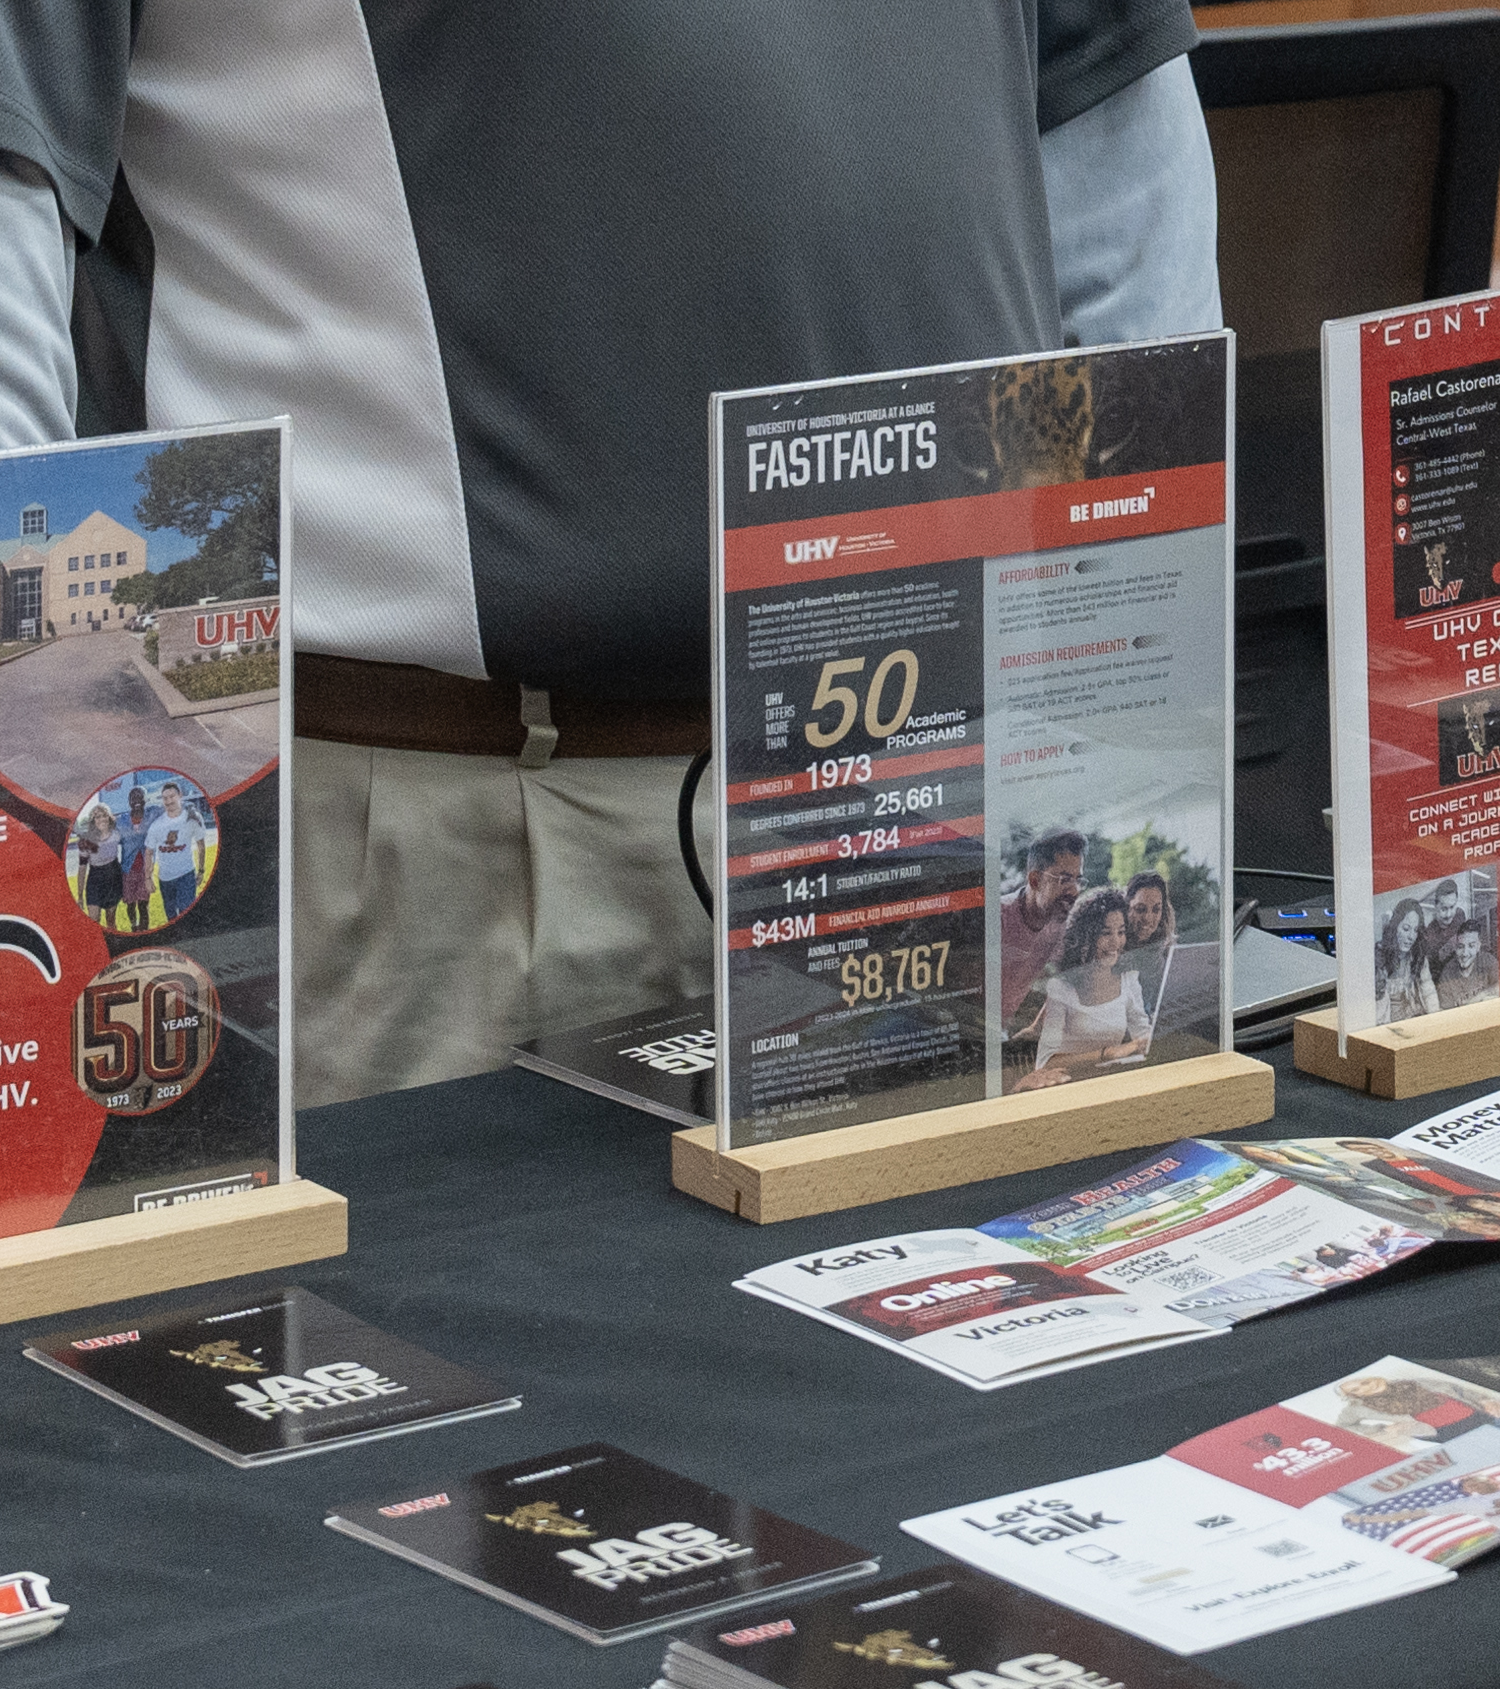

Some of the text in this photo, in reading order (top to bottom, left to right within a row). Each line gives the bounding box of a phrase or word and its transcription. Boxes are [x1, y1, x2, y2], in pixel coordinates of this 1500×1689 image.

[1391, 384, 1432, 407] Rafael
[746, 401, 936, 438] UNIVERSITY HOUSTON-VICTORIA GLANCE
[1396, 418, 1408, 430] Sr.
[749, 419, 938, 492] FASTFACTS
[1070, 496, 1148, 523] BE DRIVEN
[784, 535, 840, 564] UHV
[998, 561, 1070, 585] AFFORDABILITY
[1419, 579, 1463, 607] UHV
[194, 606, 280, 649] UHV
[1433, 614, 1481, 641] UHV
[1000, 637, 1128, 671] ADMISSION REQUIREMENTS
[804, 649, 919, 749] 50
[766, 720, 789, 735] MORE
[905, 708, 967, 729] Academic
[766, 736, 788, 751] THAN
[887, 724, 967, 750] PROGRAMS
[806, 754, 872, 791] 1973
[1000, 753, 1022, 767] HOW
[783, 783, 944, 827] CONFERRED 25,661
[1410, 797, 1476, 822] CONNECT
[783, 825, 901, 864] ENROLLMENT 3,784
[782, 868, 900, 903] 14:1 STUDENT/FACULTY
[752, 896, 950, 948] $43M AWARDED ANNUALLY
[841, 940, 951, 1007] $8,767
[162, 1016, 199, 1032] YEARS
[751, 1032, 799, 1054] LOCATION
[106, 1083, 182, 1108] 1973 2023
[794, 1241, 909, 1277] Katy
[1101, 1250, 1170, 1276] Looking
[1131, 1256, 1174, 1273] Live
[880, 1271, 1018, 1314] Online
[954, 1305, 1089, 1341] Victoria
[225, 1361, 382, 1408] JAG
[235, 1377, 408, 1422] PRIDE
[1282, 1448, 1346, 1477] million
[1368, 1449, 1458, 1495] UHV
[961, 1499, 1074, 1535] Let's
[993, 1511, 1129, 1547] Talk
[556, 1522, 720, 1576] JAG
[572, 1537, 754, 1591] PRIDE
